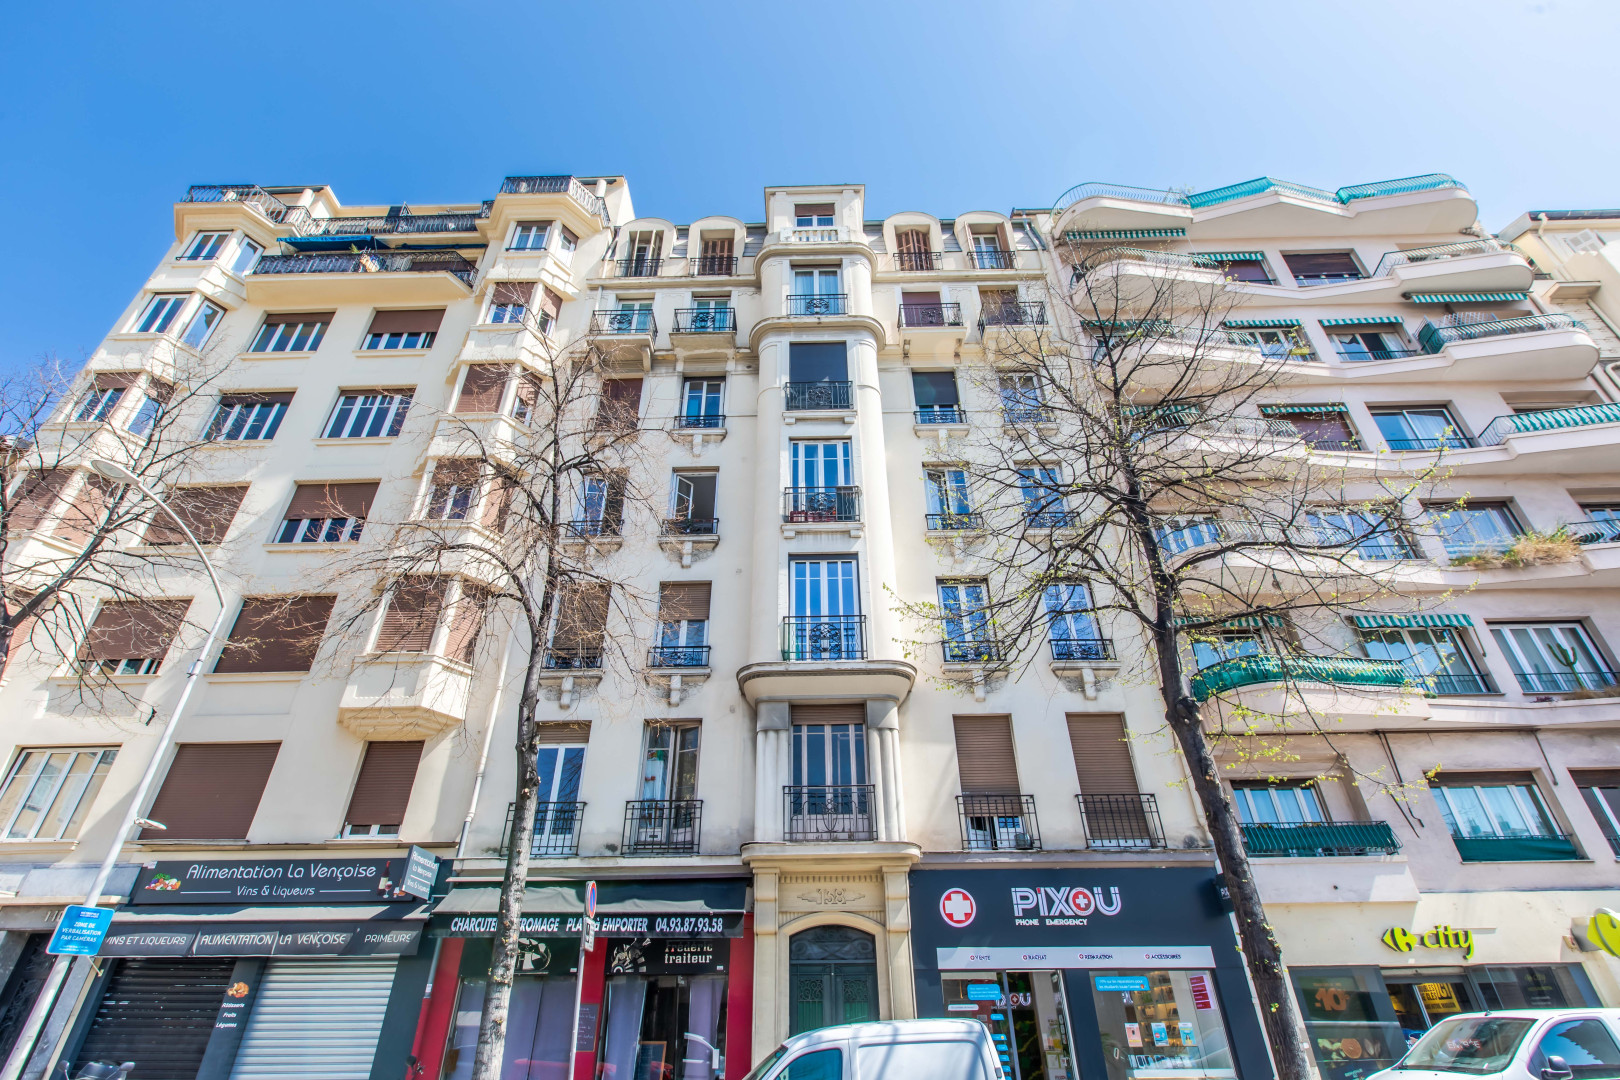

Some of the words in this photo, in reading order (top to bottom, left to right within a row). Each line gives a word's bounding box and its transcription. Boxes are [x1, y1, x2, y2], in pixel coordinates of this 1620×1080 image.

[411, 851, 438, 870] Alimentation
[186, 864, 283, 879] Alimentation
[310, 863, 376, 881] Vençoise
[236, 885, 258, 896] Vins
[261, 885, 270, 896] &
[273, 885, 315, 898] Liqueurs
[816, 888, 847, 904] 158
[451, 917, 498, 931] CHARCUTE
[520, 917, 560, 931] ROMAGE
[566, 918, 583, 931] PLA
[602, 917, 648, 931] EMPORTER
[655, 917, 723, 932] 04.93.87.93.58
[1015, 918, 1039, 926] PHONE
[1046, 918, 1088, 926] EMERGENCY
[62, 927, 102, 936] VERBALISATION
[126, 936, 141, 945] ET
[140, 936, 187, 945] LIQUEURS
[200, 934, 274, 945] ALIMENTATION
[279, 934, 293, 944] LA
[297, 934, 347, 947] VENÇOISE
[364, 934, 412, 943] PRIMEURS
[1422, 924, 1474, 960] city
[664, 952, 713, 964] traiteur
